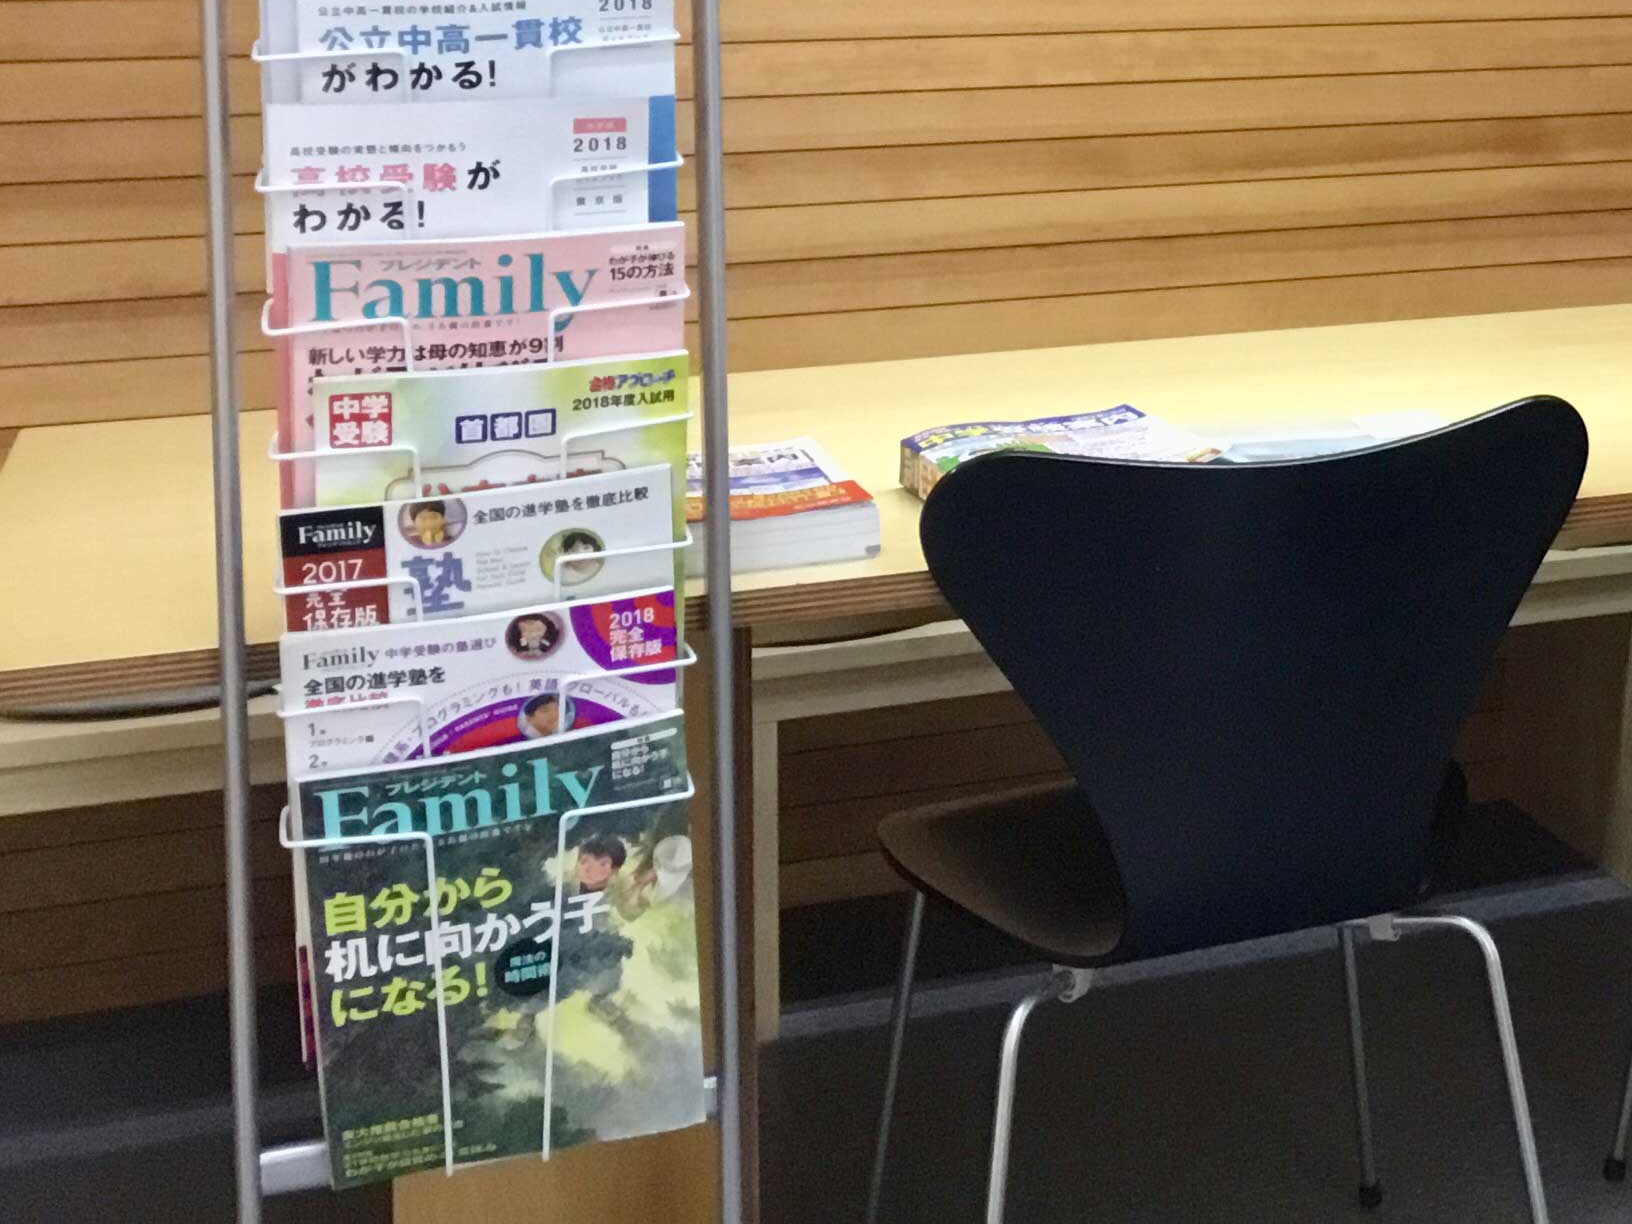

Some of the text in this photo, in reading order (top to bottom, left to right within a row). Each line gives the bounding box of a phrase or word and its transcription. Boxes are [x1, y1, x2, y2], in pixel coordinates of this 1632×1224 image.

[319, 16, 583, 56] 公立中高一貫校
[573, 136, 627, 152] 2018
[610, 262, 674, 281] 15の方法
[308, 253, 598, 333] Family
[333, 394, 391, 417] 中学
[572, 389, 676, 412] 2018年度入試用
[332, 421, 391, 446] 受験
[473, 485, 649, 526] 全国の進学塾を徹底比較
[298, 520, 377, 545] Family
[301, 559, 364, 585] 2017
[400, 551, 473, 614] 塾
[302, 605, 379, 632] 保存版
[609, 607, 655, 629] 2018
[609, 626, 645, 646] 完全
[303, 645, 379, 671] Family
[303, 667, 446, 697] 全国の進学塾を
[314, 757, 605, 851] Family
[324, 867, 513, 936] 自分から
[324, 892, 610, 984] 机に向かう子
[331, 961, 489, 1027] になる!
